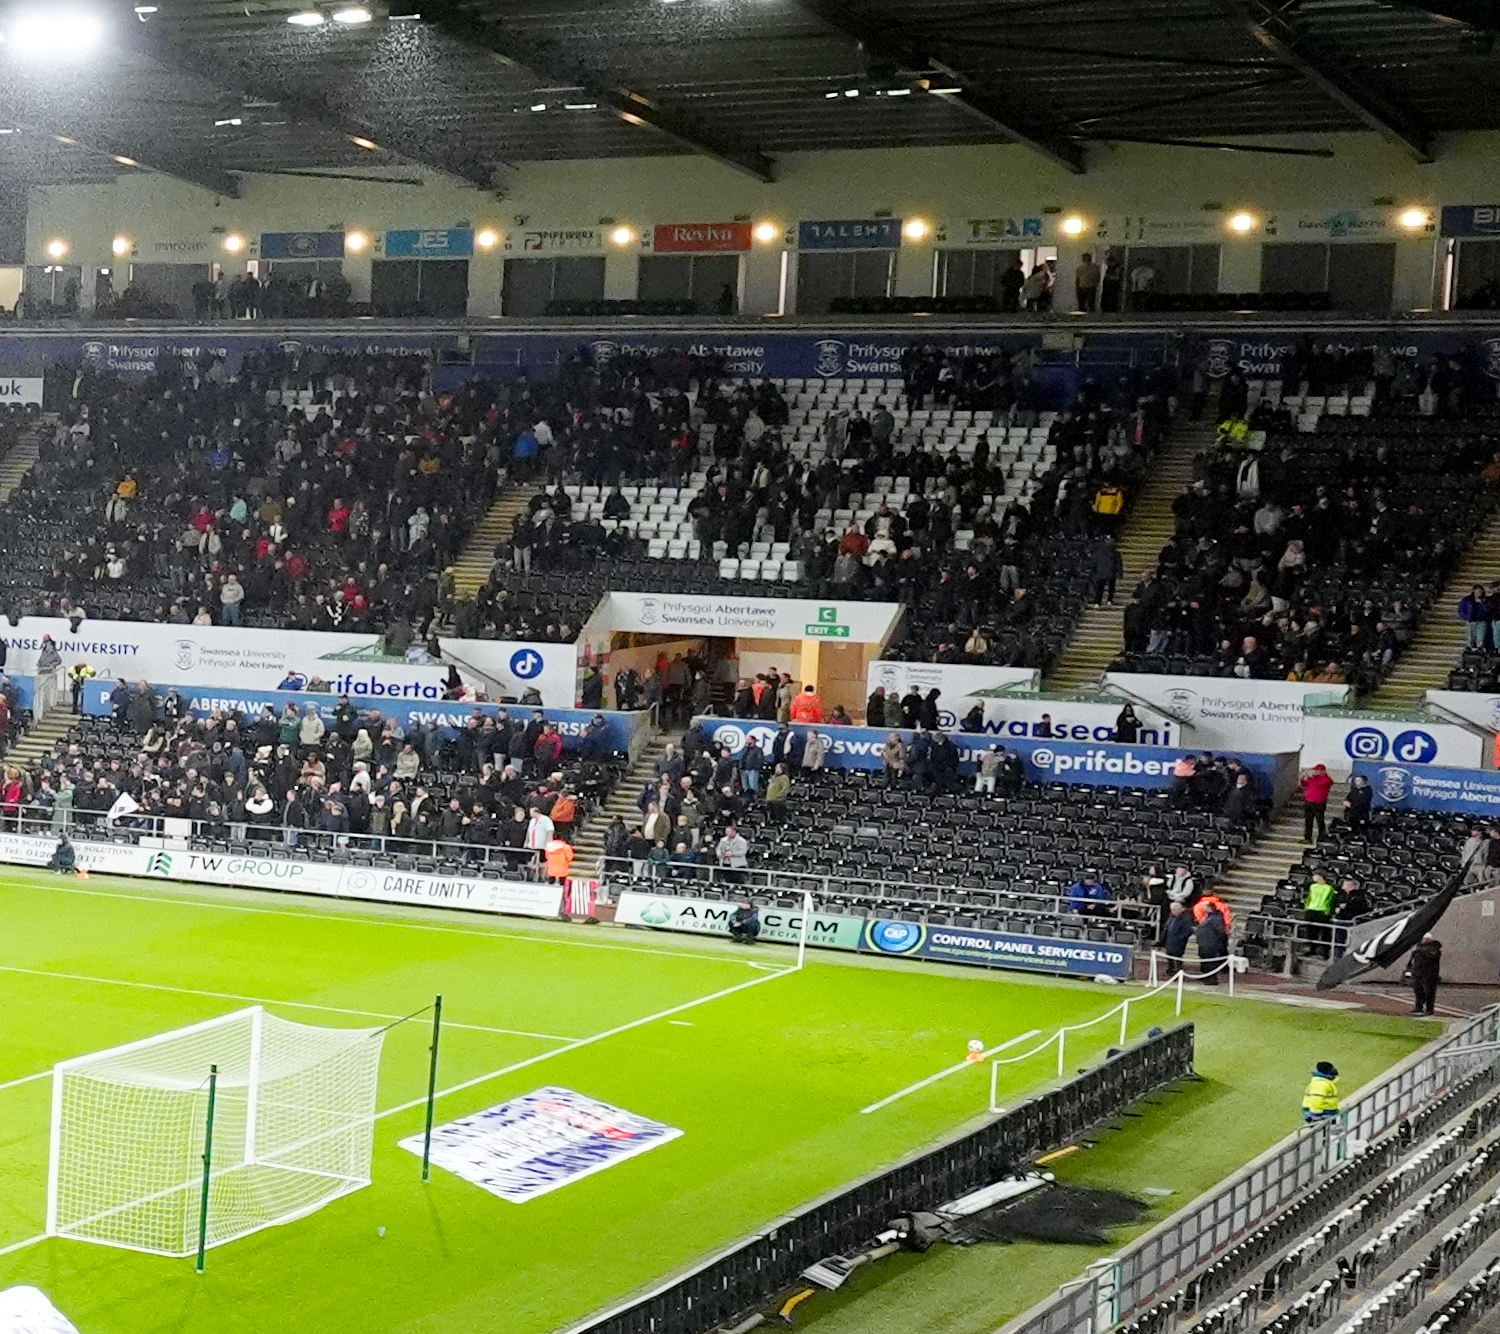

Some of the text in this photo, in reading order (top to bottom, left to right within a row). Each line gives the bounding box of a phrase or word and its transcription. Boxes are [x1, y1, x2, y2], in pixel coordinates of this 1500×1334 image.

[1240, 343, 1287, 360] Prifys
[107, 359, 156, 372] Swanse
[846, 360, 902, 374] Swans
[663, 601, 777, 617] Prifysgol Abertawe
[661, 612, 777, 629] Swansea University
[807, 626, 828, 635] EXIT
[56, 638, 141, 656] UNIVERSITY
[200, 646, 287, 661] Swansea University
[198, 657, 285, 671] Prifysgol Abertawe
[297, 673, 446, 700] rifaberta
[1202, 696, 1305, 714] Prifysgol Aberta
[1200, 708, 1305, 724] Swansea Univer
[1031, 748, 1180, 777] @prifaber
[1412, 775, 1461, 791] Swansea
[1412, 786, 1458, 802] Prifysgol
[4, 846, 23, 855] Tel:
[22, 838, 81, 853] SCAFFOG
[83, 845, 134, 857] SOLUTIONS
[188, 854, 304, 880] TW GROUP
[382, 875, 424, 896] CARE
[428, 878, 477, 900] UNITY
[675, 919, 837, 944] IT CABLI PECIAISTS
[932, 932, 1124, 965] CONTROL PANEL SERVICES LTD
